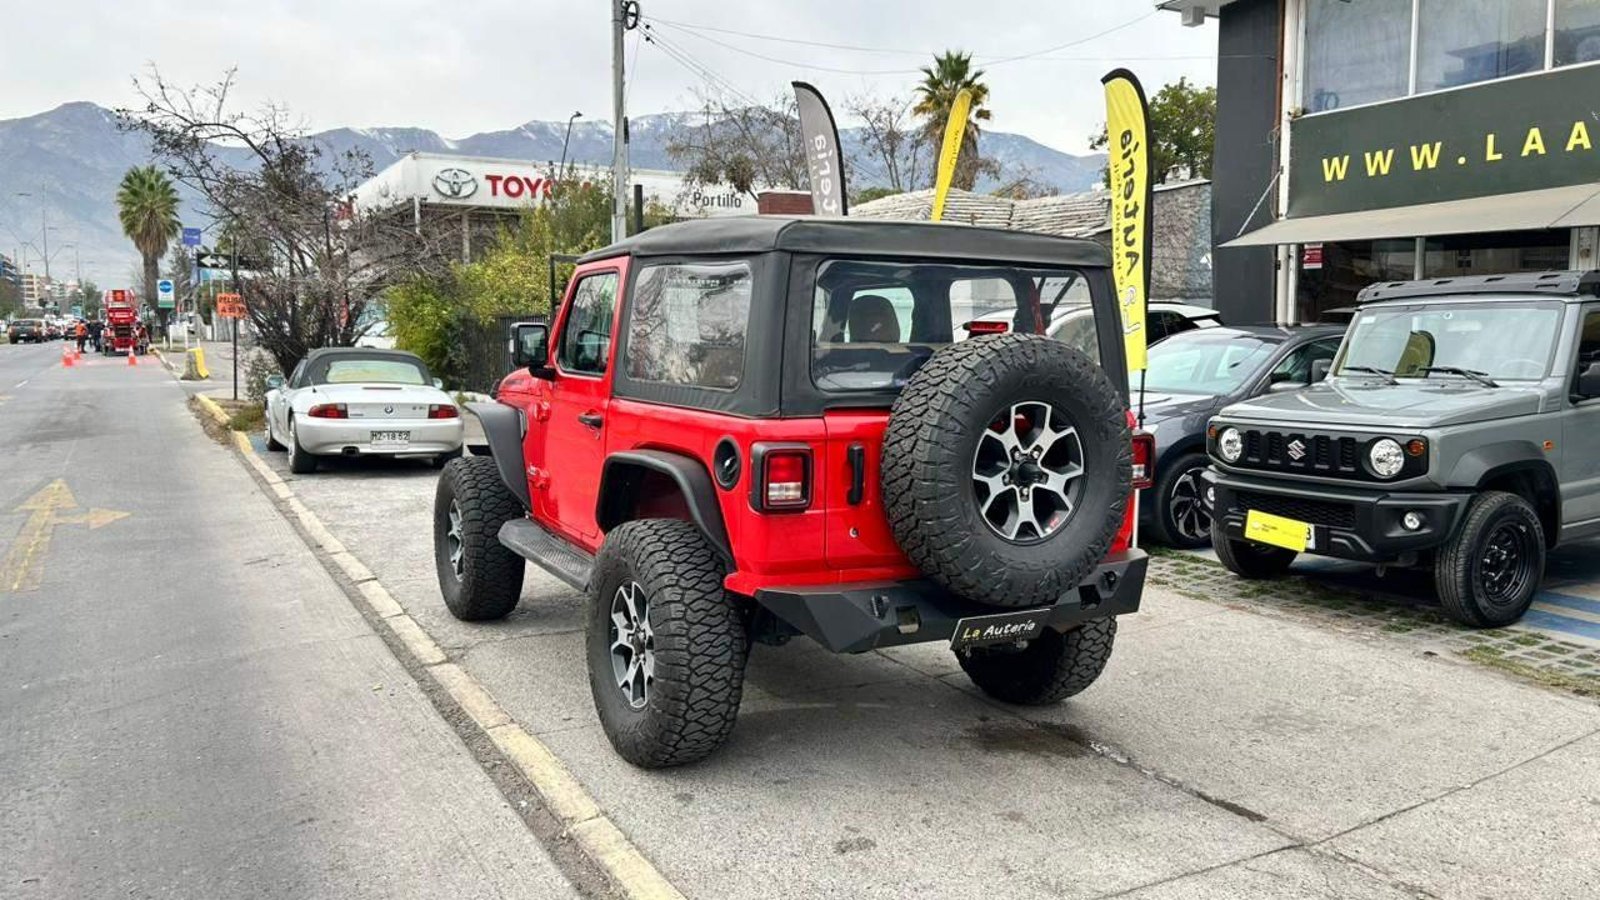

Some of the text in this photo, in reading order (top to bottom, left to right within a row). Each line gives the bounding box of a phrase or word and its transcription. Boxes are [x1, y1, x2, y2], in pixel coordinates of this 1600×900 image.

[693, 191, 742, 208] Portillo
[962, 626, 981, 640] La
[983, 619, 1036, 638] Autería
